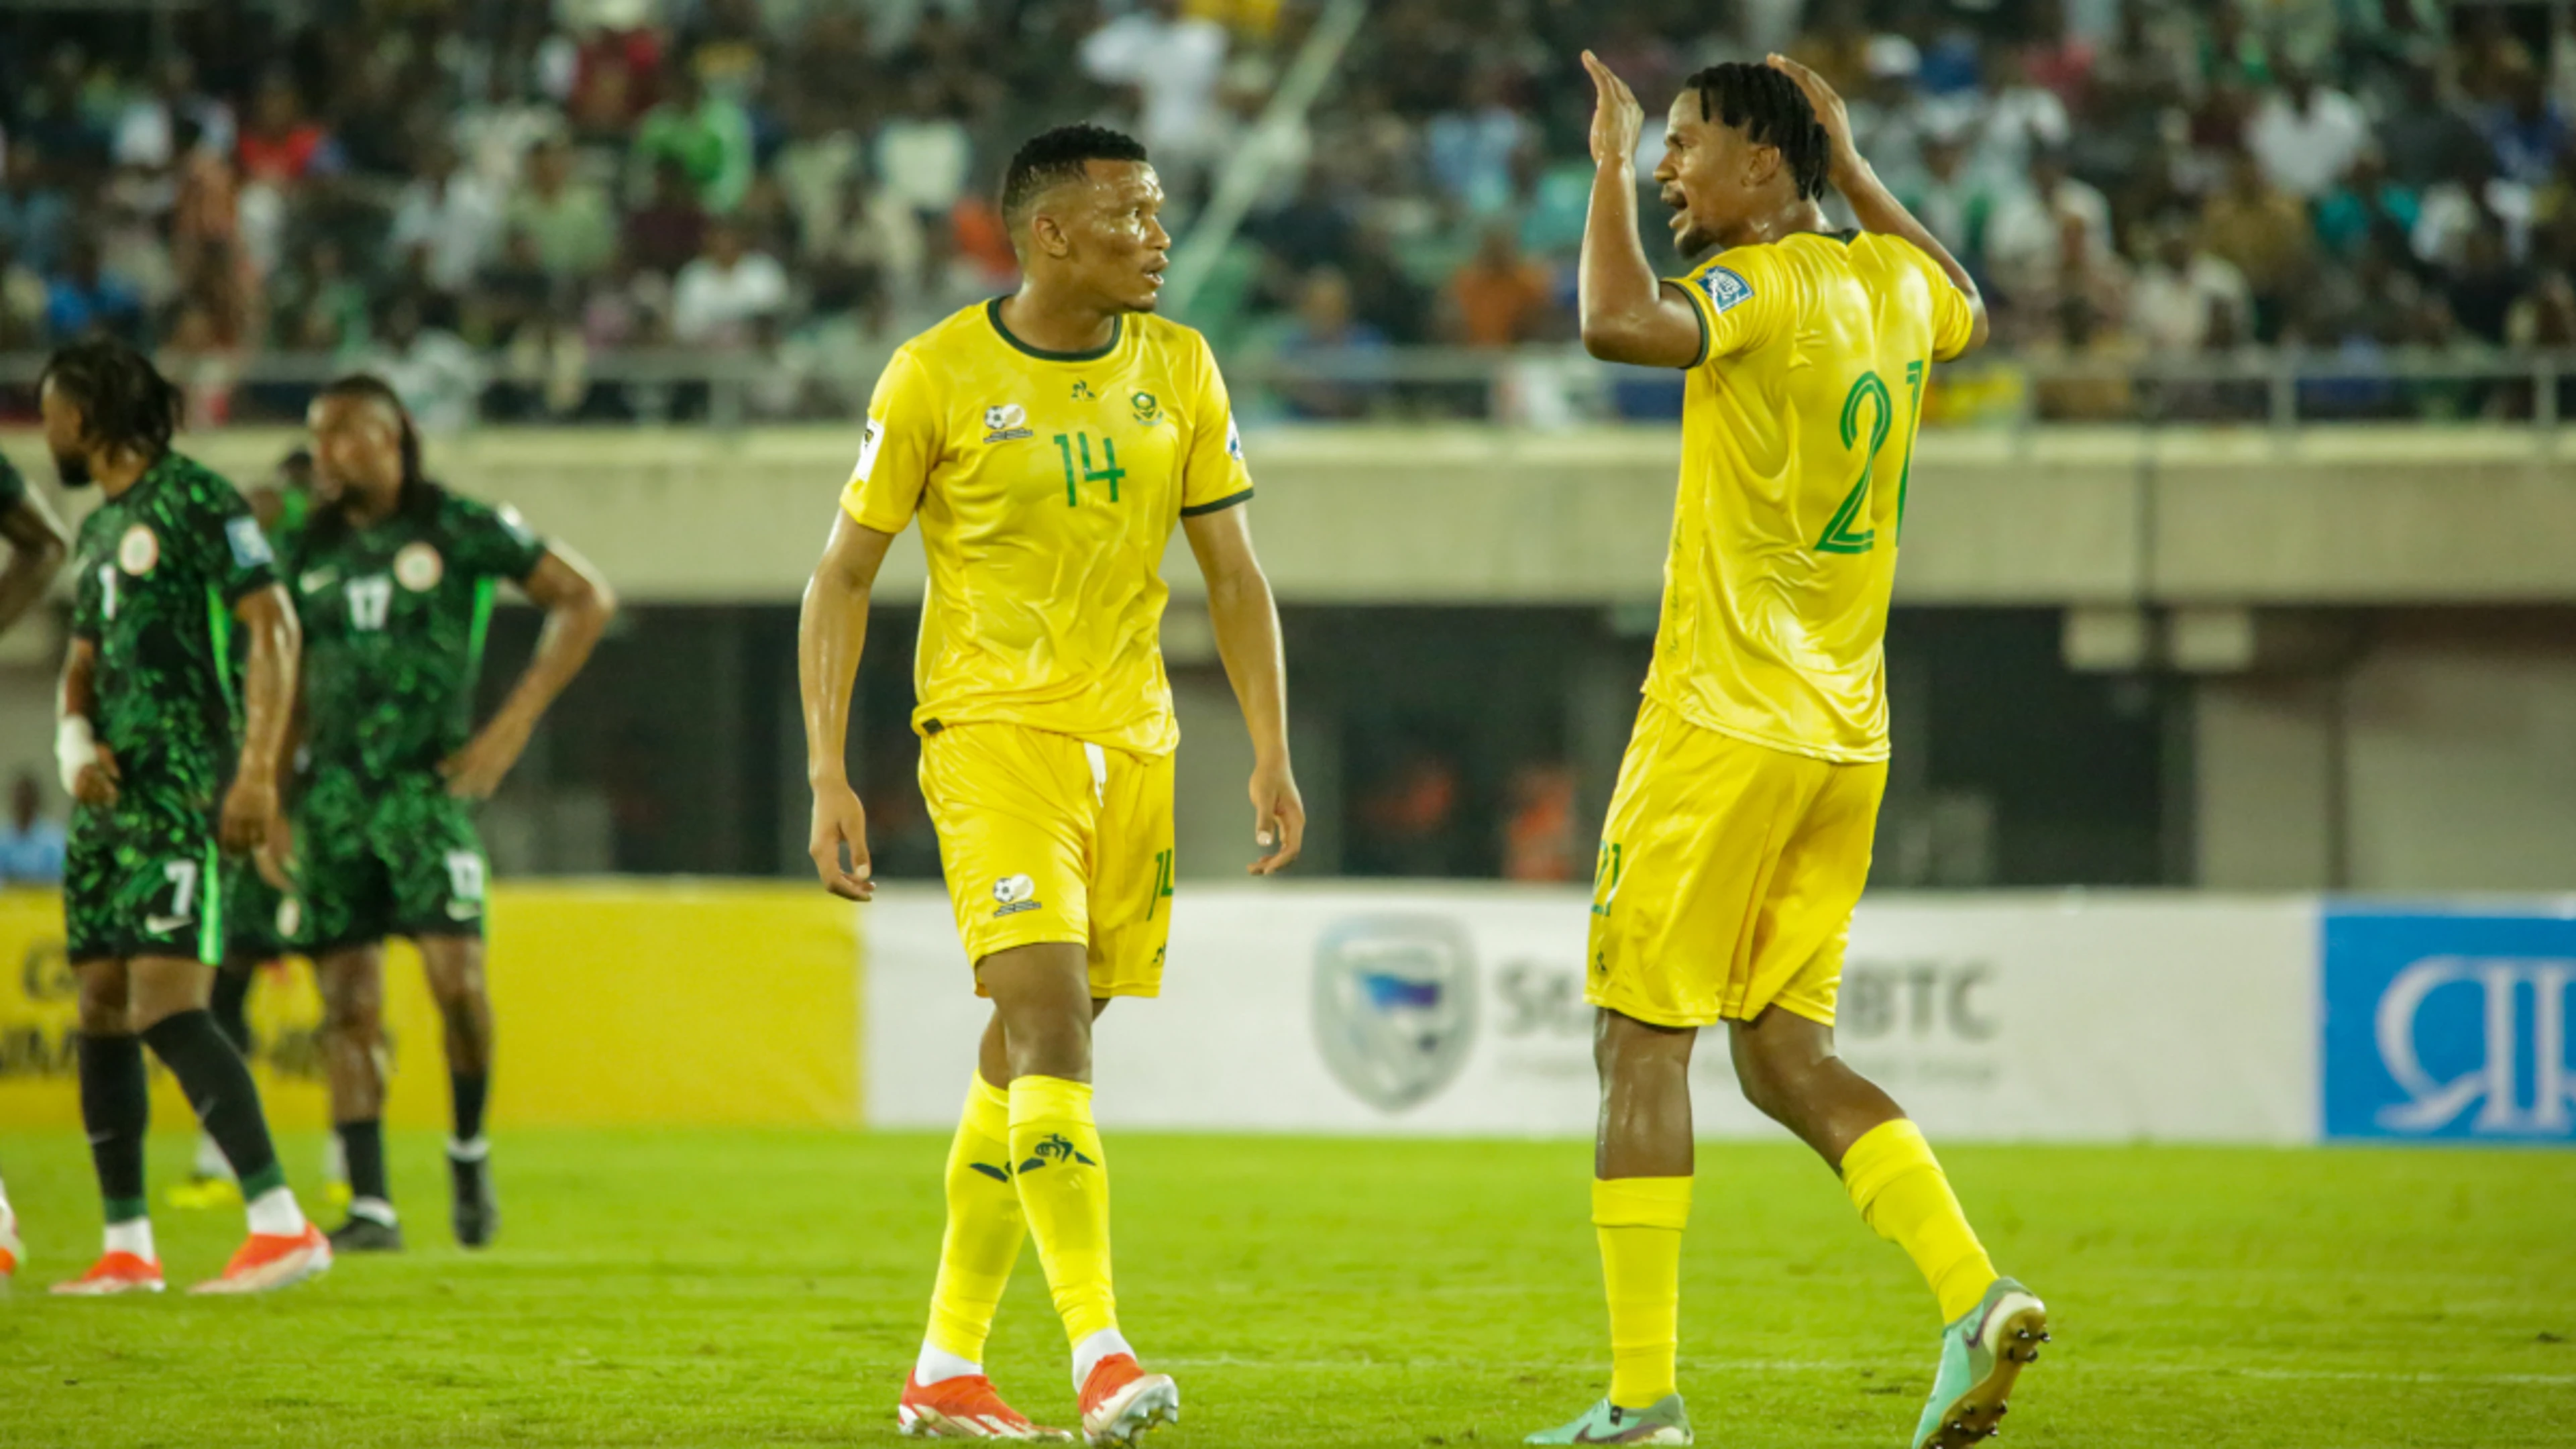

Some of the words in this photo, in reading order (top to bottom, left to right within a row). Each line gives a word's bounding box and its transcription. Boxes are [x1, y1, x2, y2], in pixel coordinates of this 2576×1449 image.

[1055, 432, 1126, 507] 14
[1814, 360, 1923, 553] 21
[164, 860, 196, 916] 7
[1839, 959, 2004, 1042] BTC
